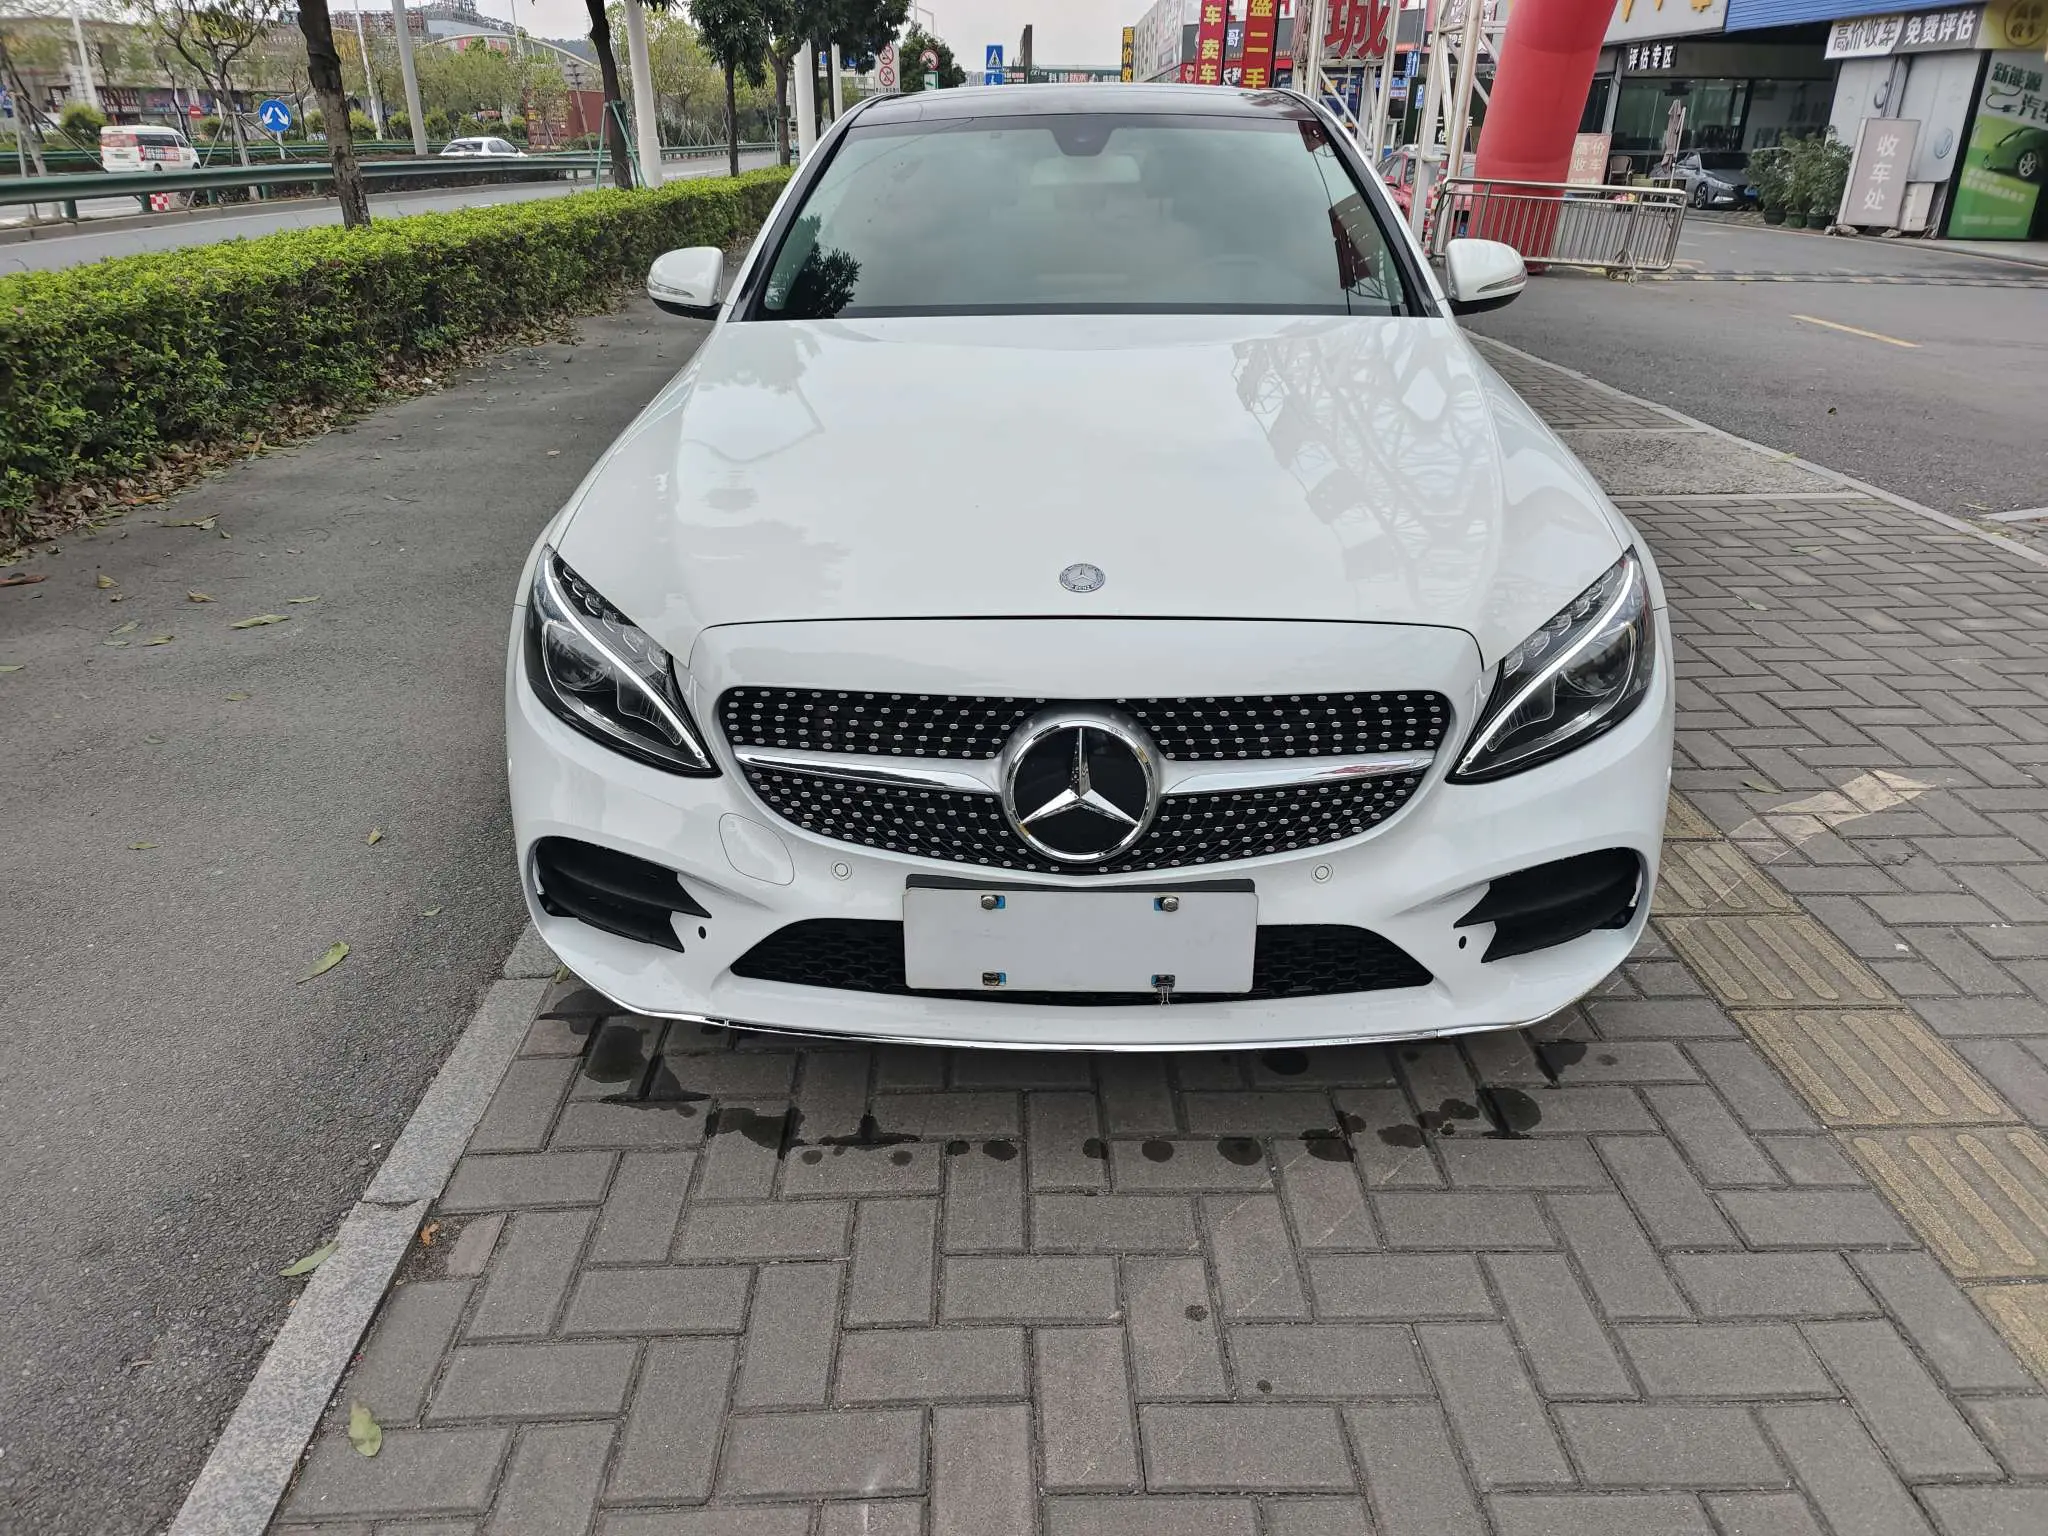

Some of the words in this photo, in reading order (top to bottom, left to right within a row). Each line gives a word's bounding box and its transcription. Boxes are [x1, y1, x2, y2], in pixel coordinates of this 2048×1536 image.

[1200, 4, 1222, 84] 车卖车
[1833, 18, 1899, 52] 高价收车
[1904, 10, 1977, 45] 免费评估
[1628, 44, 1674, 71] 评估专区
[1990, 61, 2043, 93] 新能源
[1863, 133, 1900, 211] 收车处
